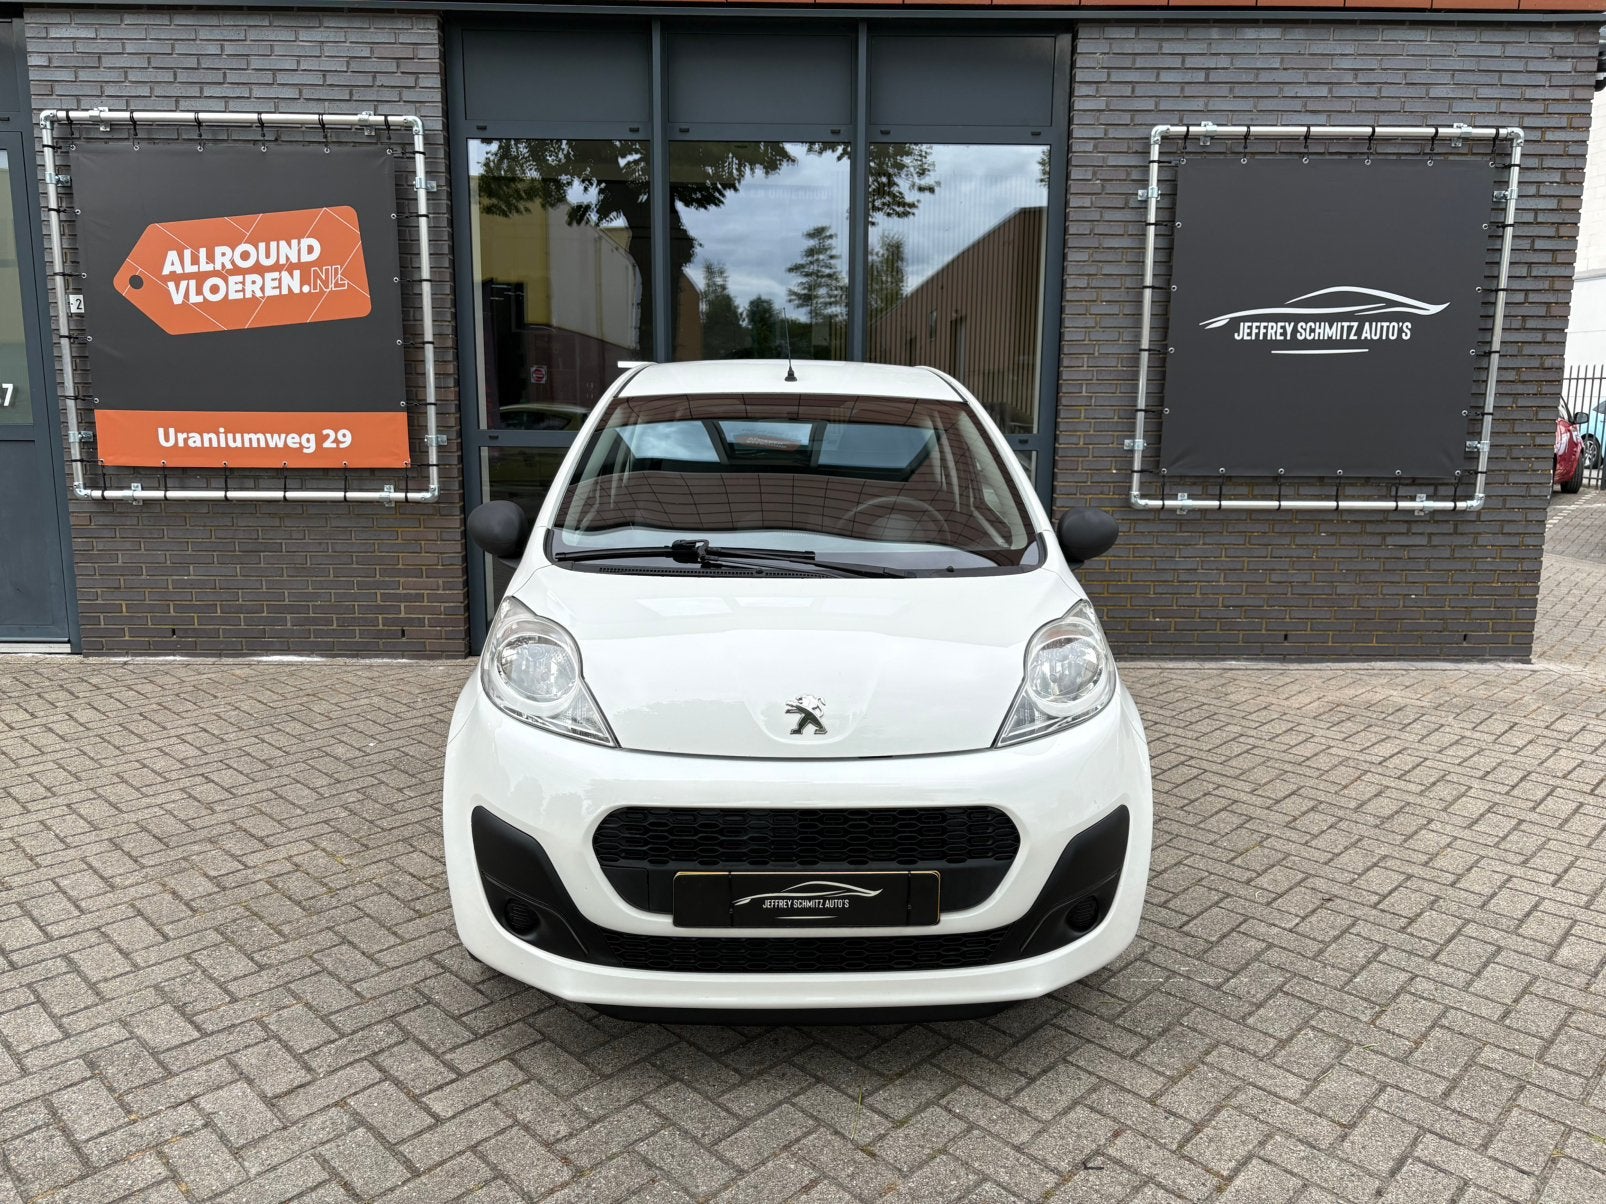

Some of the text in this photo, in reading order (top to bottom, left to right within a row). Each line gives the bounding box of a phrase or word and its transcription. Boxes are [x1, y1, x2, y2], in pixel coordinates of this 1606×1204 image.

[161, 237, 321, 276] ALLROUND
[167, 265, 348, 305] VLOEREN.NL
[75, 298, 83, 310] 2
[1235, 322, 1411, 340] JEFFREY SCHMITZ AUTO'S
[0, 383, 14, 407] 7
[157, 427, 352, 454] Uraniumweg 29
[763, 899, 849, 908] JEFFREY SCHMITZ AUTO'S
